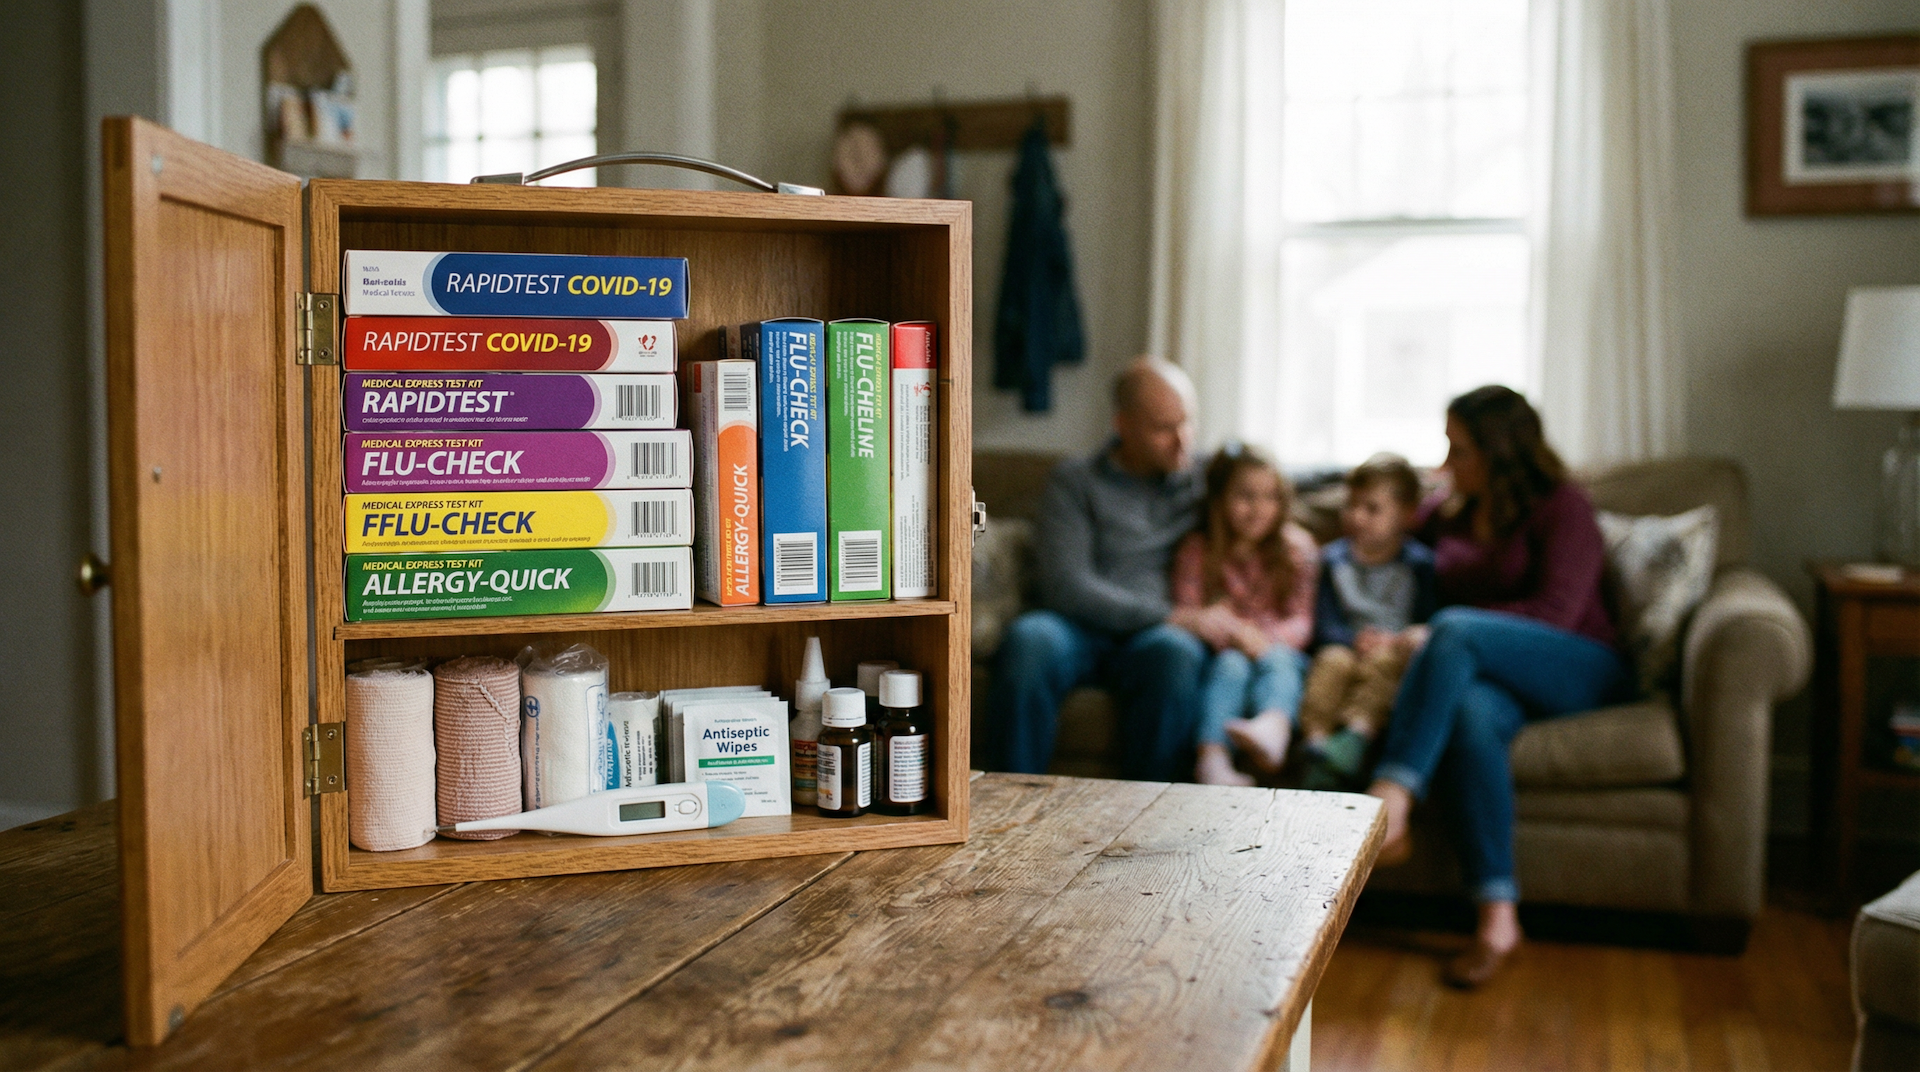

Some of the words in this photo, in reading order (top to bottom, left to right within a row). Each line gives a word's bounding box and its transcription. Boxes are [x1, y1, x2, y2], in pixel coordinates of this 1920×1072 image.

[446, 272, 565, 294] RAPIDTEST
[567, 275, 673, 297] COVID-19
[363, 331, 483, 352] RAPIDTEST
[486, 332, 592, 353] COVID-19
[362, 379, 403, 389] MEDICAL
[405, 379, 444, 388] EXPRESS
[445, 379, 467, 388] TEST
[468, 379, 484, 388] KIT
[789, 331, 810, 450] FLU-CHECK
[856, 332, 875, 459] FLU-CHELINE
[361, 440, 403, 449] MEDICAL
[405, 439, 444, 448] EXPRESS
[445, 439, 467, 448] TEST
[468, 439, 484, 447] KIT
[361, 450, 525, 476] FLU-CHECK
[362, 501, 404, 510] MEDICAL
[405, 501, 444, 509] EXPRESS
[446, 500, 467, 509] TEST
[468, 500, 484, 508] KIT
[361, 510, 537, 537] FFLU-CHECK
[733, 463, 751, 597] ALLERGY-QUICK
[362, 561, 405, 571] MEDICAL
[405, 560, 445, 570] EXPRESS
[446, 559, 469, 569] TEST
[469, 559, 484, 568] KIT
[362, 567, 573, 596] ALLERGY-QUICK
[702, 726, 770, 740] Antiseptic
[716, 741, 758, 755] Wipes
